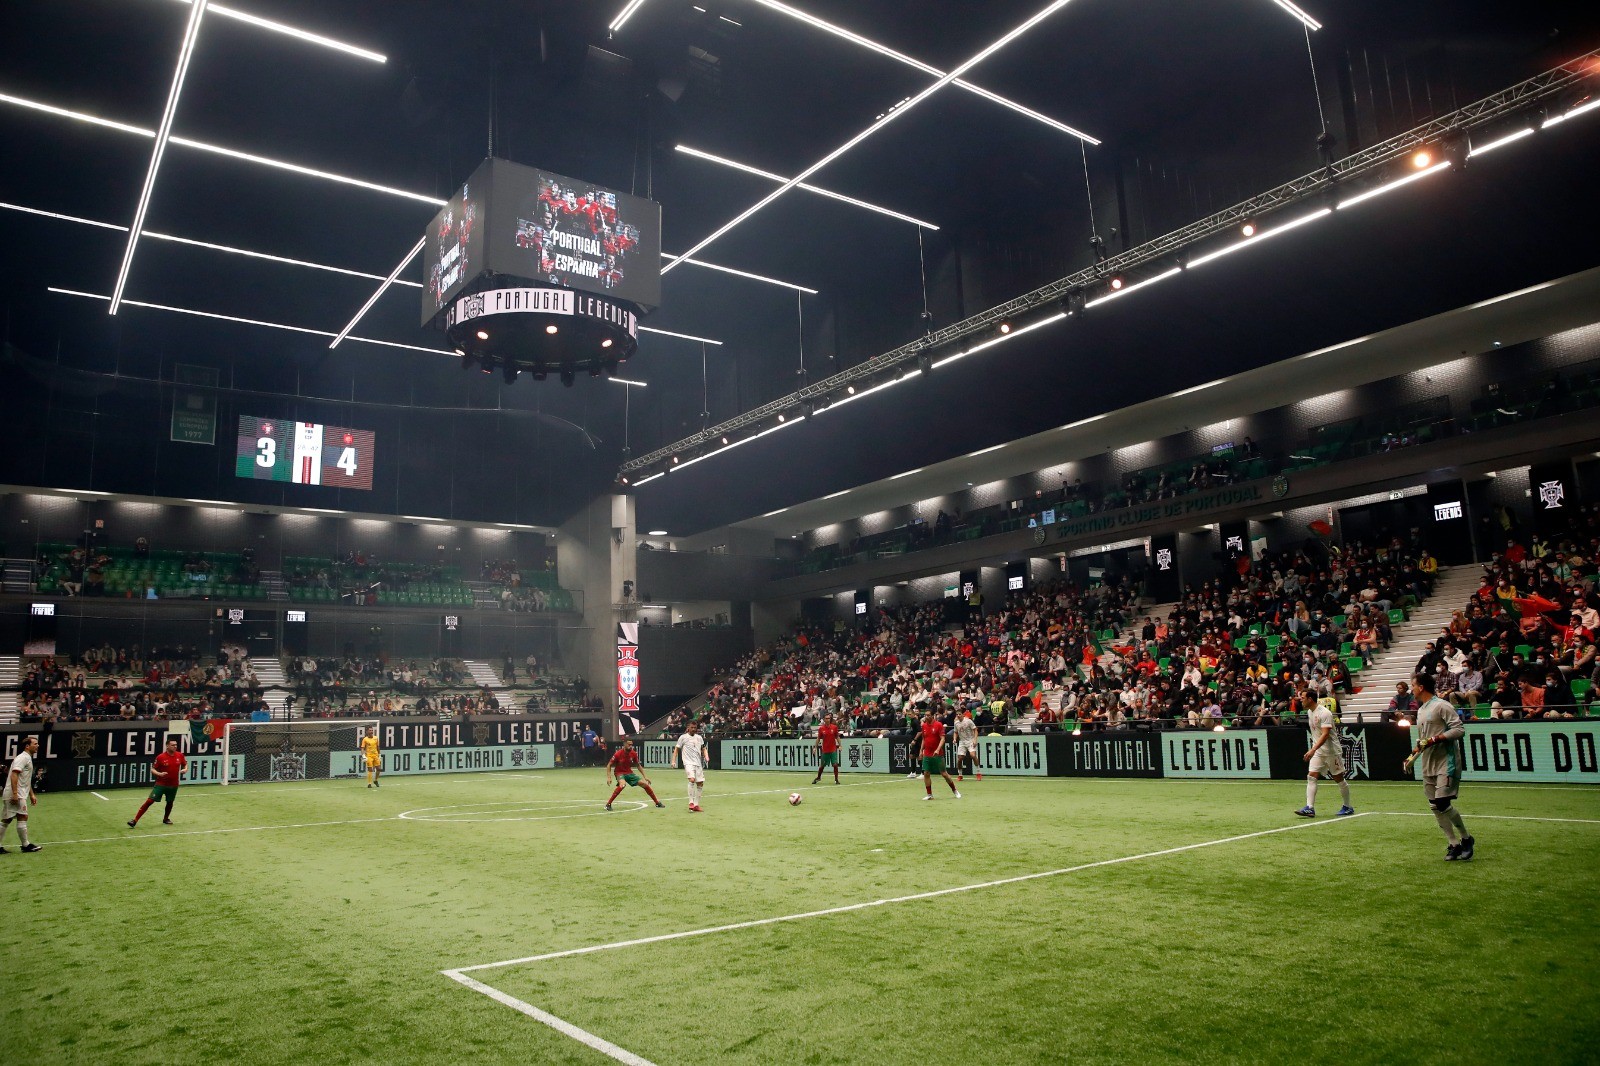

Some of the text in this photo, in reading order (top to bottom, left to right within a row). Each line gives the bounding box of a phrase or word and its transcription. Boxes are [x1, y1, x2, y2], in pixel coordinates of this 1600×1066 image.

[553, 230, 602, 256] PORTUGAL
[555, 253, 599, 278] ESPANHA
[496, 292, 628, 328] PORTUGAL LEGENDS
[256, 437, 276, 468] 3
[337, 447, 358, 477] 4
[1056, 486, 1262, 539] SPORTING CLUBE DE PORTUGAL
[1435, 506, 1463, 521] LEGENDS
[394, 753, 410, 771] DO
[419, 748, 503, 771] CENTENÁRIO
[732, 745, 754, 766] JOGO
[759, 745, 770, 766] DO
[977, 741, 1040, 769] LEGENDS
[1074, 740, 1156, 770] PORTUGAL
[1170, 738, 1260, 770] LEGENDS
[1551, 732, 1598, 772] DO
